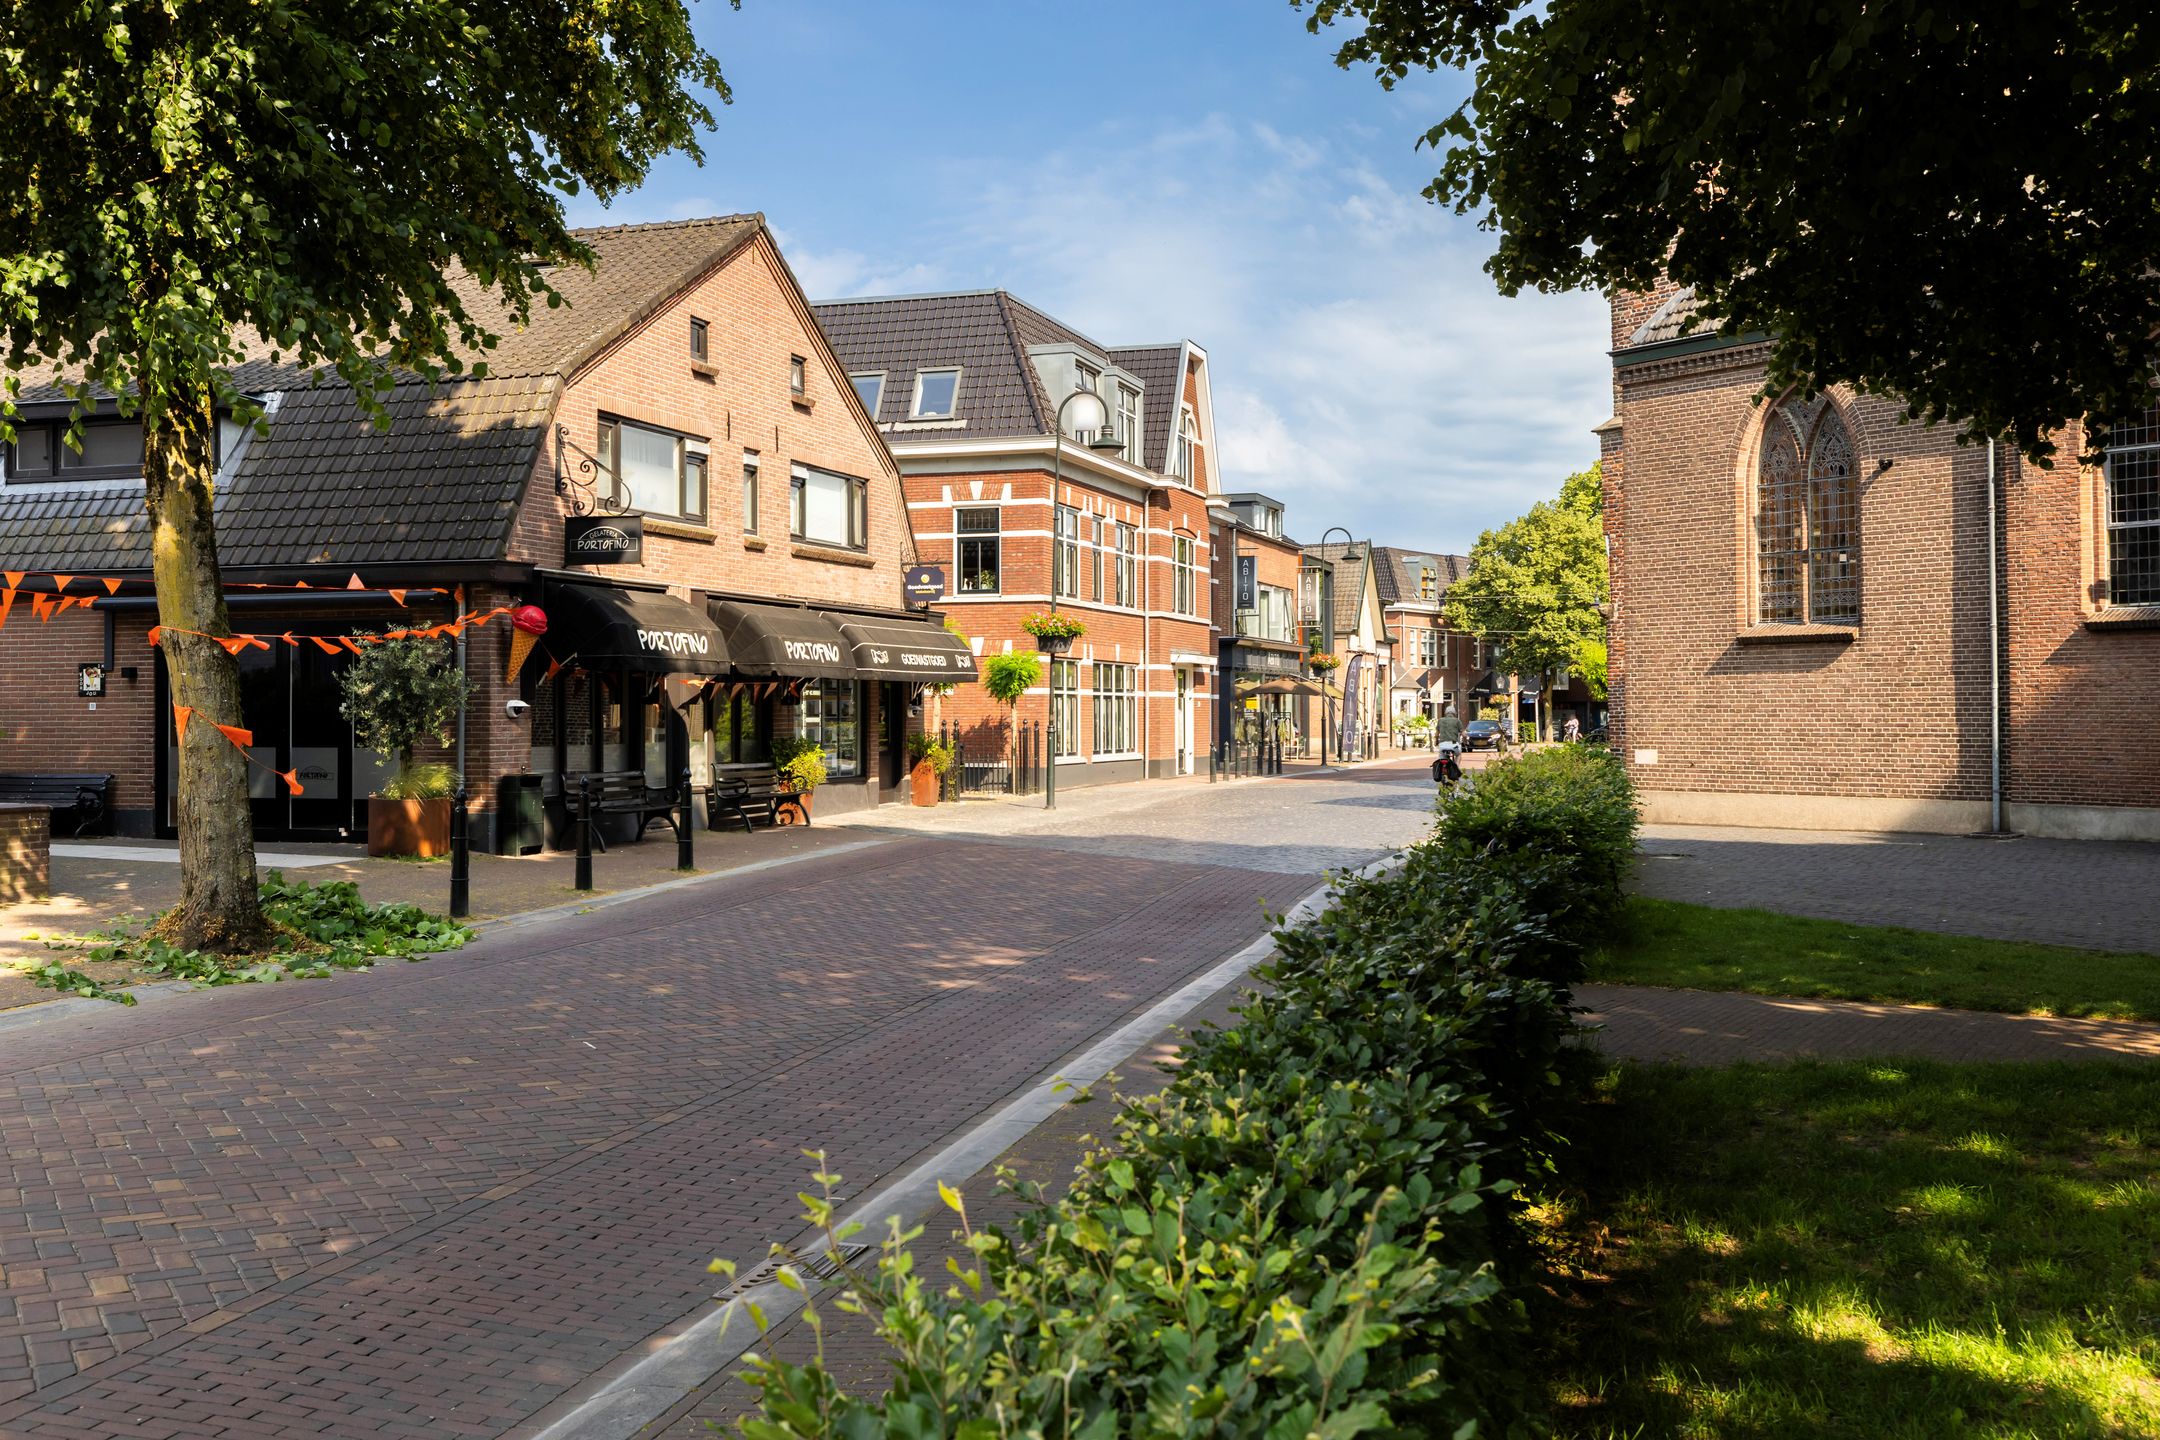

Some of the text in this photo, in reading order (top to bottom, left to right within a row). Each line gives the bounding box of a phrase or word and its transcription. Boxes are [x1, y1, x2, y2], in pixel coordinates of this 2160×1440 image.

[589, 529, 618, 539] GELATERIA
[577, 538, 629, 551] PORTOFINO
[636, 629, 708, 655] PORTOFINO
[784, 641, 840, 664] PORTOFINO
[901, 653, 947, 667] GOEDVASTGOED
[1345, 661, 1357, 744] ABITO
